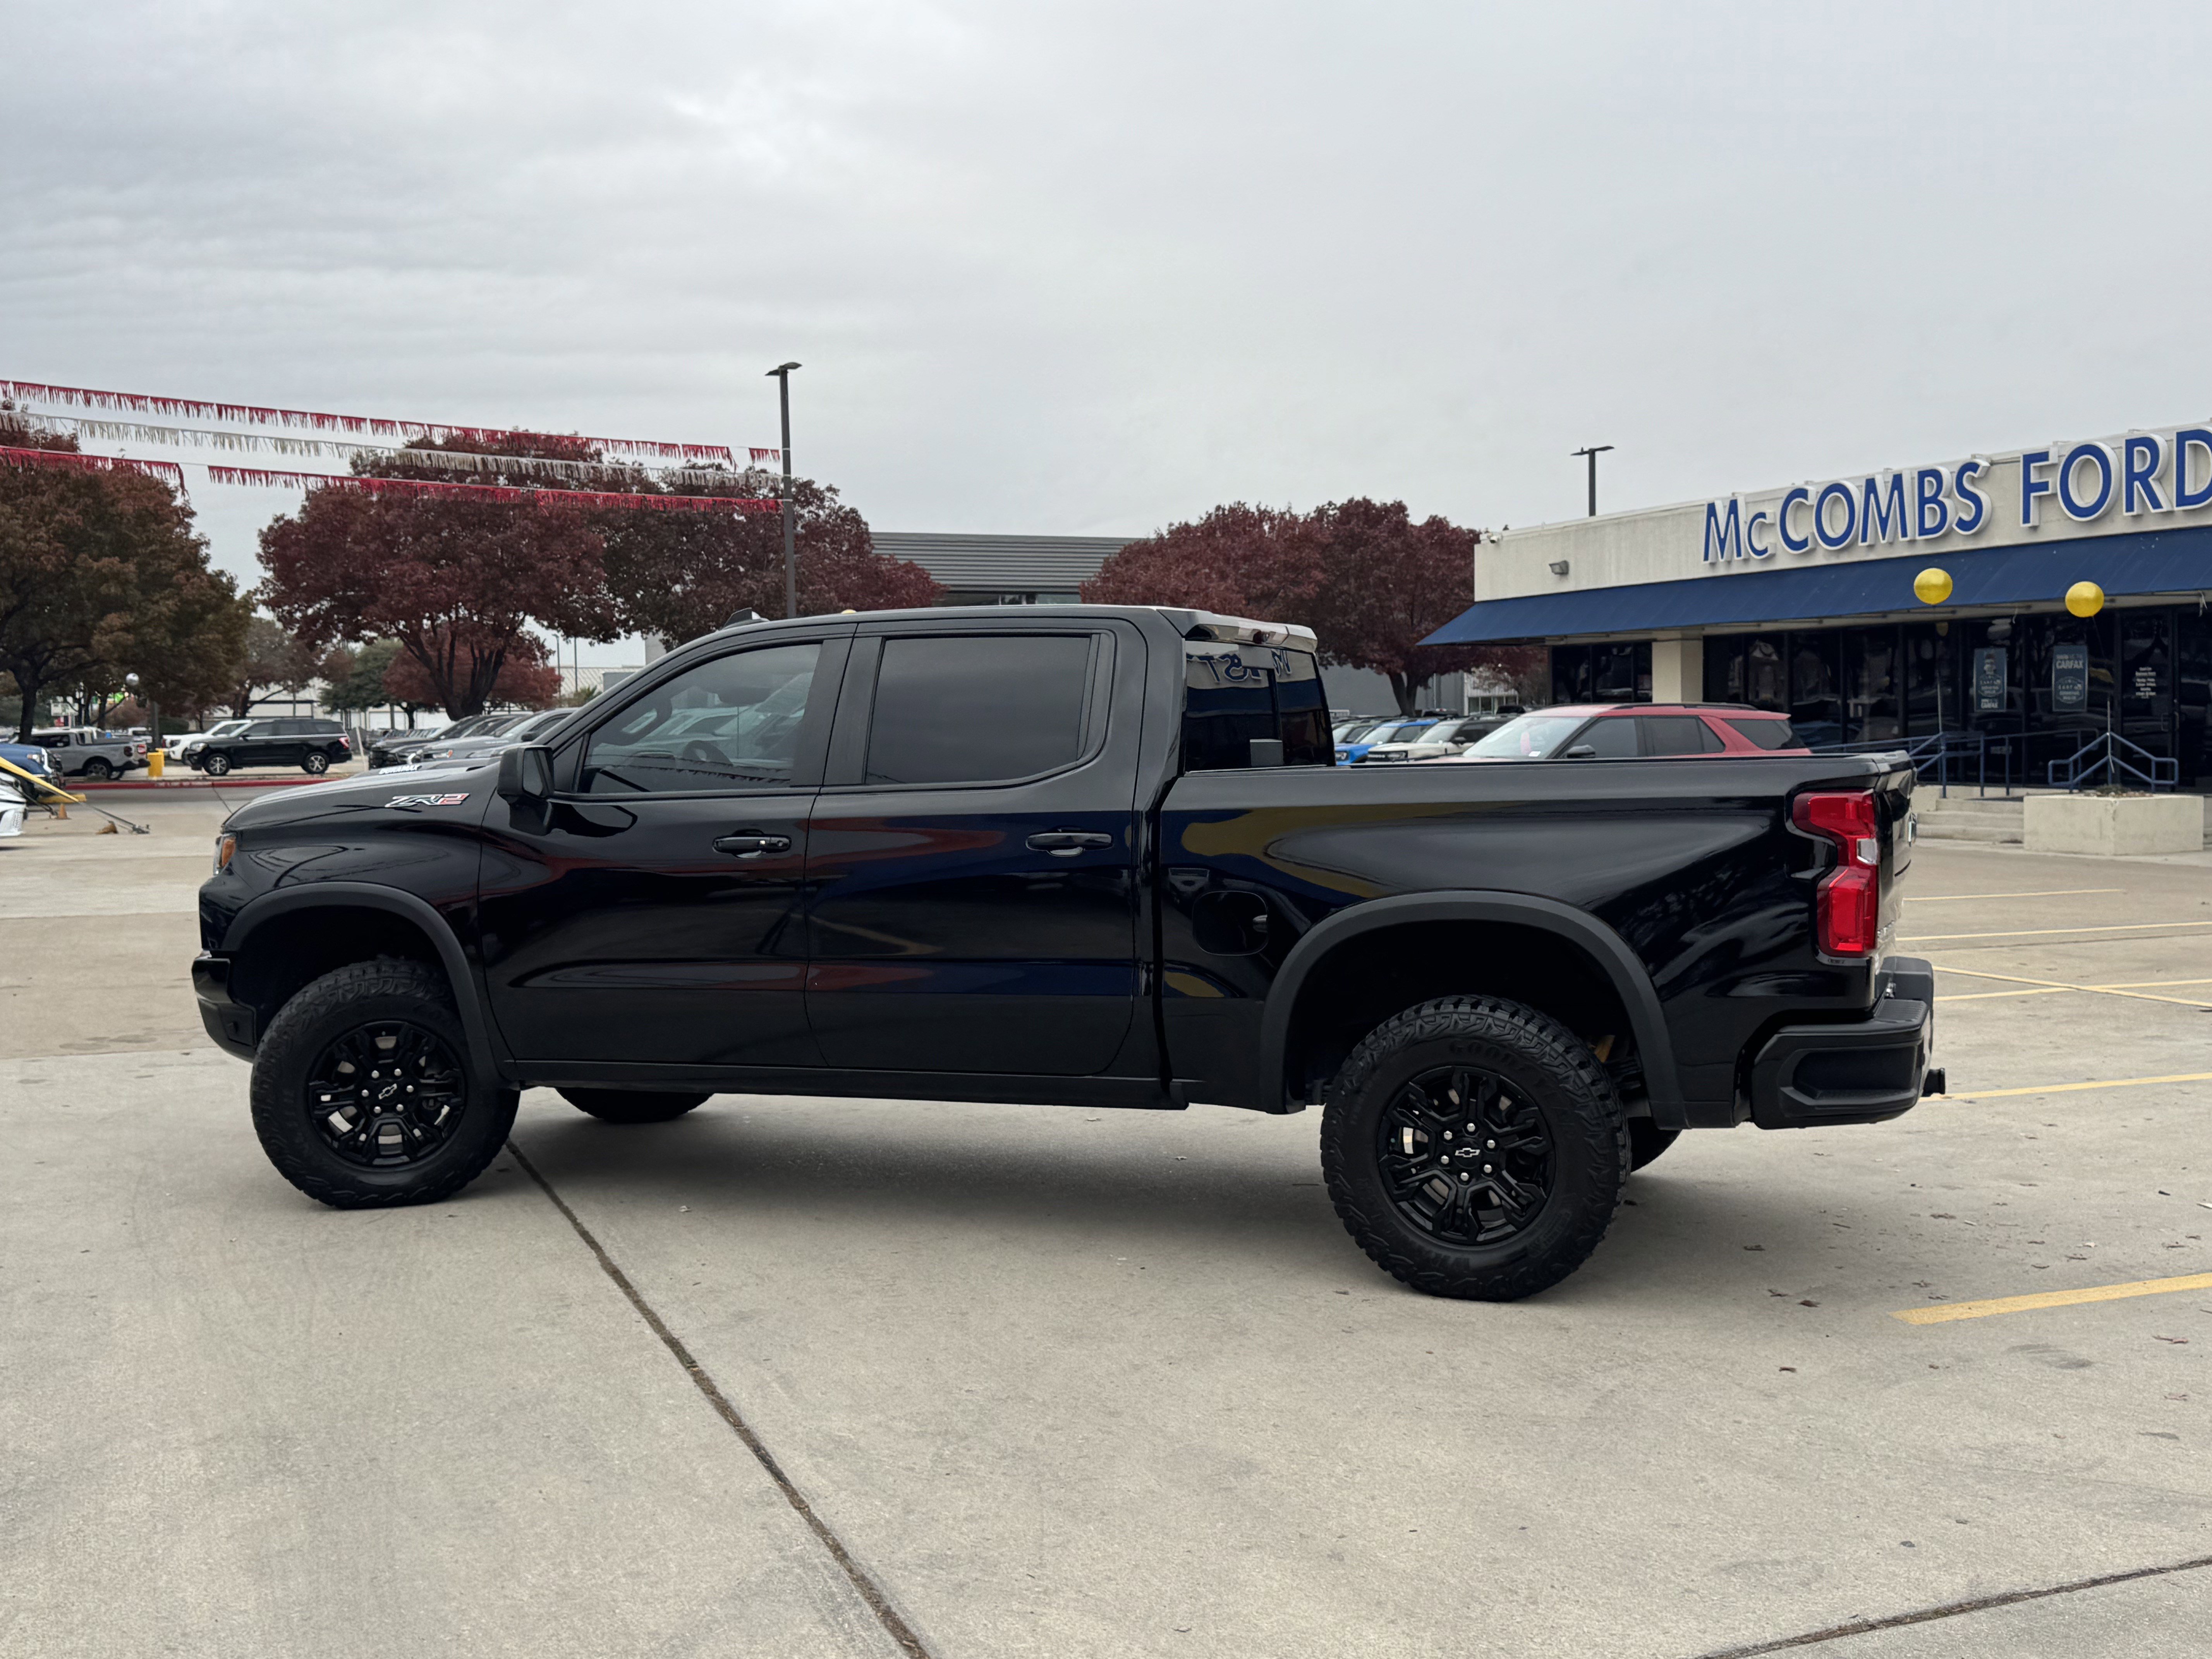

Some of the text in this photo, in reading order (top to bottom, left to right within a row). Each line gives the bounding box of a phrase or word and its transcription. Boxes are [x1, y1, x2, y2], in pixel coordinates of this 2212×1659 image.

[1703, 427, 2212, 563] McCOMBS FORD
[2056, 660, 2083, 669] CARFAX
[385, 793, 470, 808] ZR2
